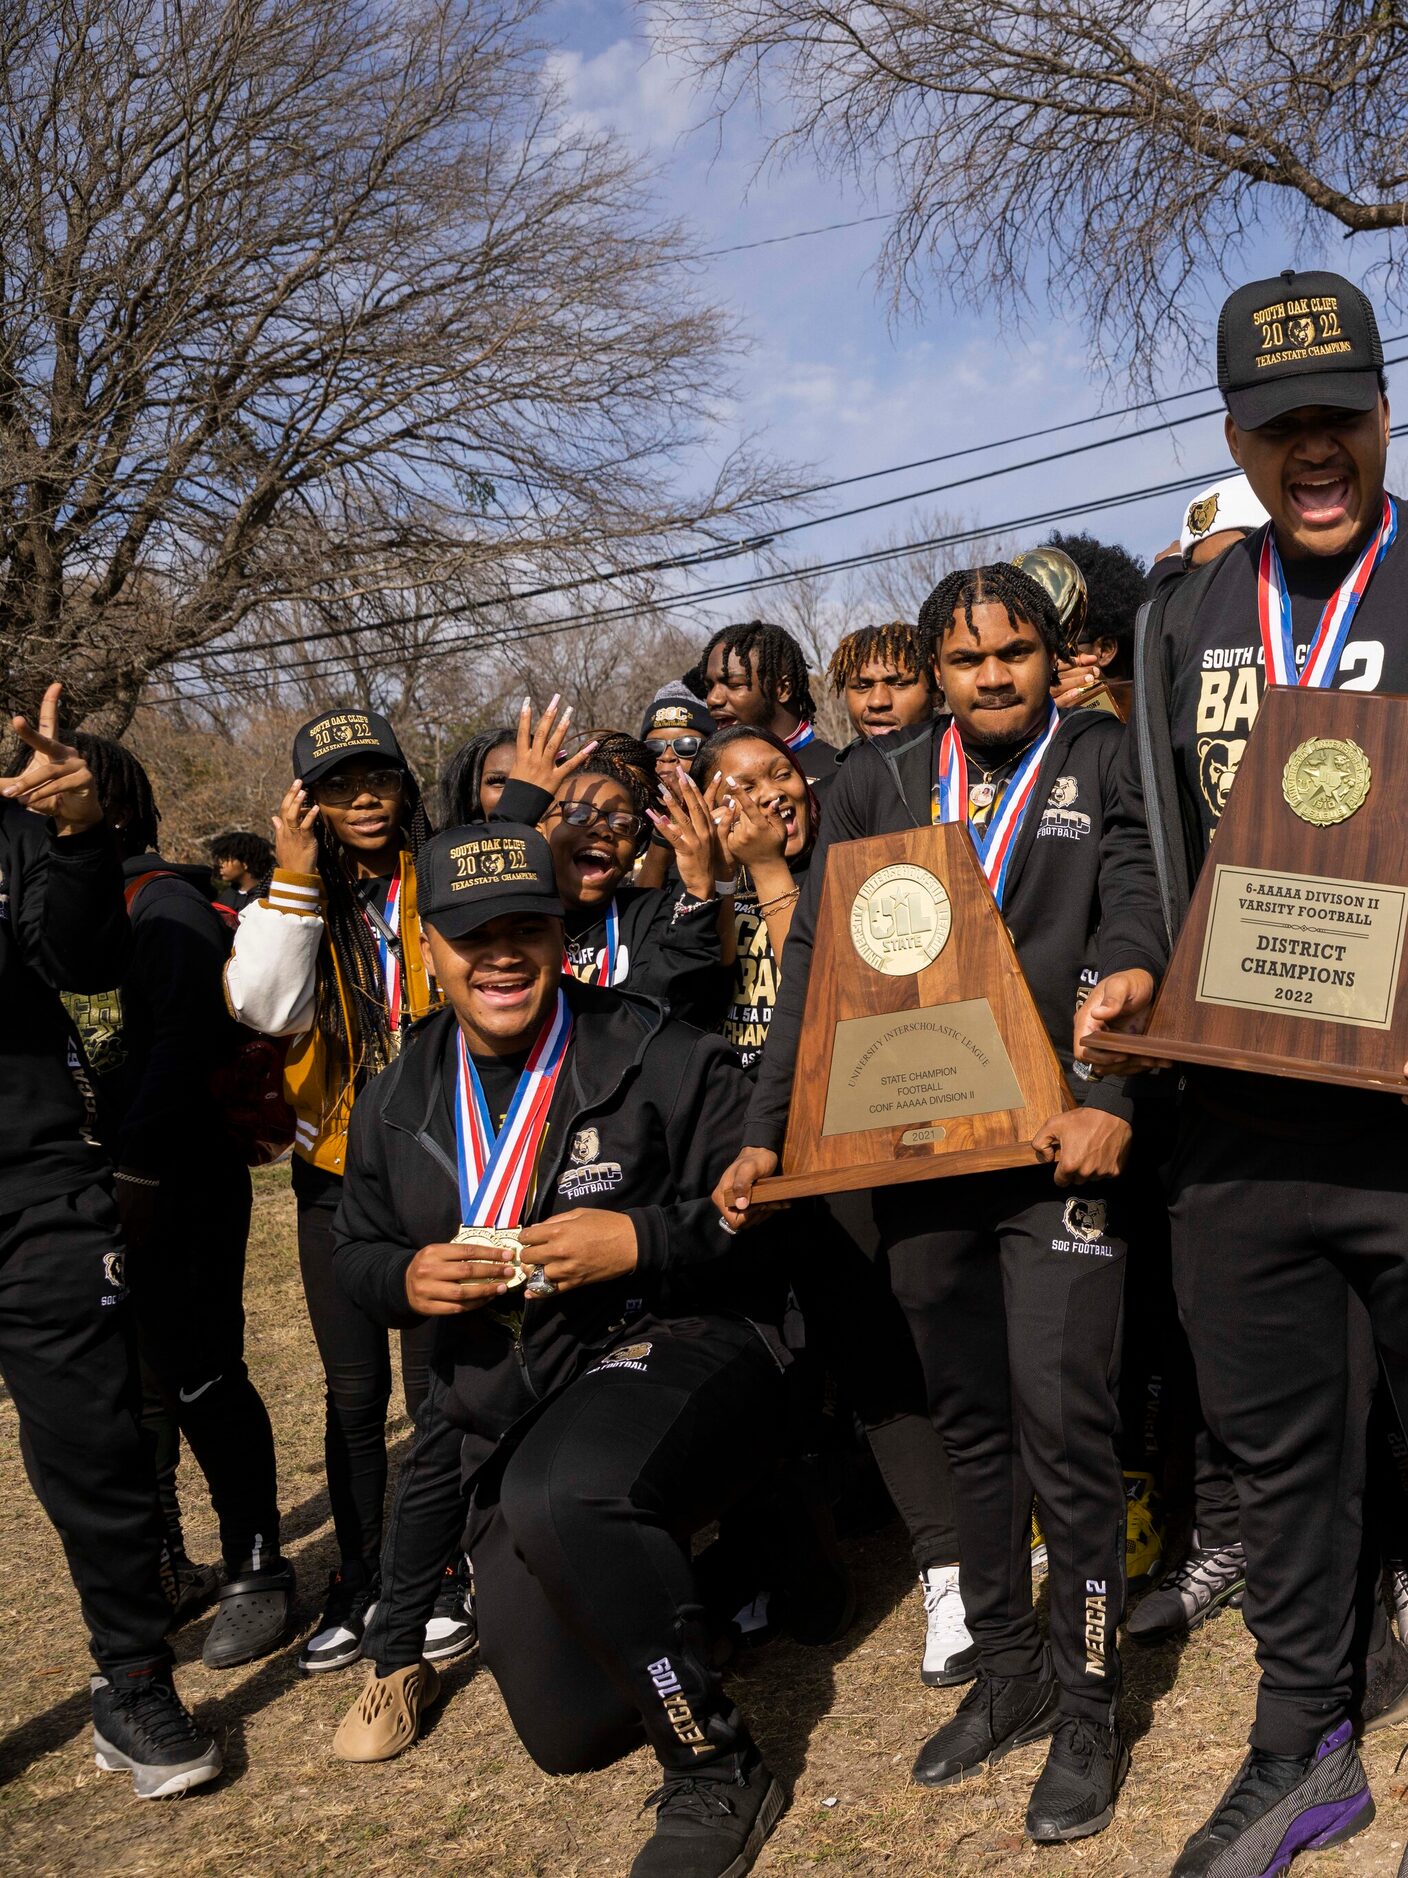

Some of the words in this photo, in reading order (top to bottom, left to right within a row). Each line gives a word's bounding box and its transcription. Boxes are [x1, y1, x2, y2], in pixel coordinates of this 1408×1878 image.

[1253, 303, 1285, 325] SOUTH
[1288, 300, 1308, 315] OAK
[1311, 298, 1338, 311] CLIFF
[1262, 323, 1283, 349] 20
[1320, 313, 1341, 338] 22
[1256, 352, 1282, 367] TEXAS
[1282, 349, 1307, 362] STATE
[1308, 341, 1351, 358] CHAMPIONS
[1203, 646, 1252, 669] SOUTH
[309, 718, 331, 738] SOUTH
[331, 716, 347, 727] OAK
[315, 730, 331, 748] 20
[354, 724, 372, 738] 22
[312, 746, 330, 759] TEXAS
[1036, 826, 1081, 840] FOOTBALL
[450, 843, 480, 859] SOUTH
[481, 839, 501, 852] OAK
[456, 856, 476, 877] 20
[509, 851, 527, 869] 22
[450, 879, 475, 892] TEXAS
[1246, 882, 1302, 900] 6-AAAAA
[1304, 889, 1365, 908] DIVISON
[1367, 898, 1380, 910] II
[1238, 898, 1296, 916] VARSITY
[1297, 905, 1373, 926] FOOTBALL
[882, 936, 923, 953] STATE
[1256, 934, 1347, 961] DISTRICT
[1241, 957, 1356, 988] CHAMPIONS
[1274, 987, 1314, 1004] 2022
[847, 1039, 884, 1089] UNIVERSITY
[883, 1020, 962, 1043] INTERSCHOLASTIC
[960, 1035, 990, 1068] LEAGUE
[880, 1072, 908, 1086] STATE
[908, 1066, 958, 1081] CHAMPION
[897, 1081, 944, 1097] FOOTBALL
[869, 1101, 895, 1114] CONF
[896, 1096, 928, 1110] AAAAA
[929, 1091, 969, 1107] DIVISION
[969, 1090, 976, 1100] II
[911, 1129, 936, 1143] 2021
[557, 1162, 623, 1194] SOC
[567, 1181, 616, 1200] FOOTBALL
[1051, 1239, 1070, 1253] SOC
[1071, 1241, 1114, 1259] FOOTBALL
